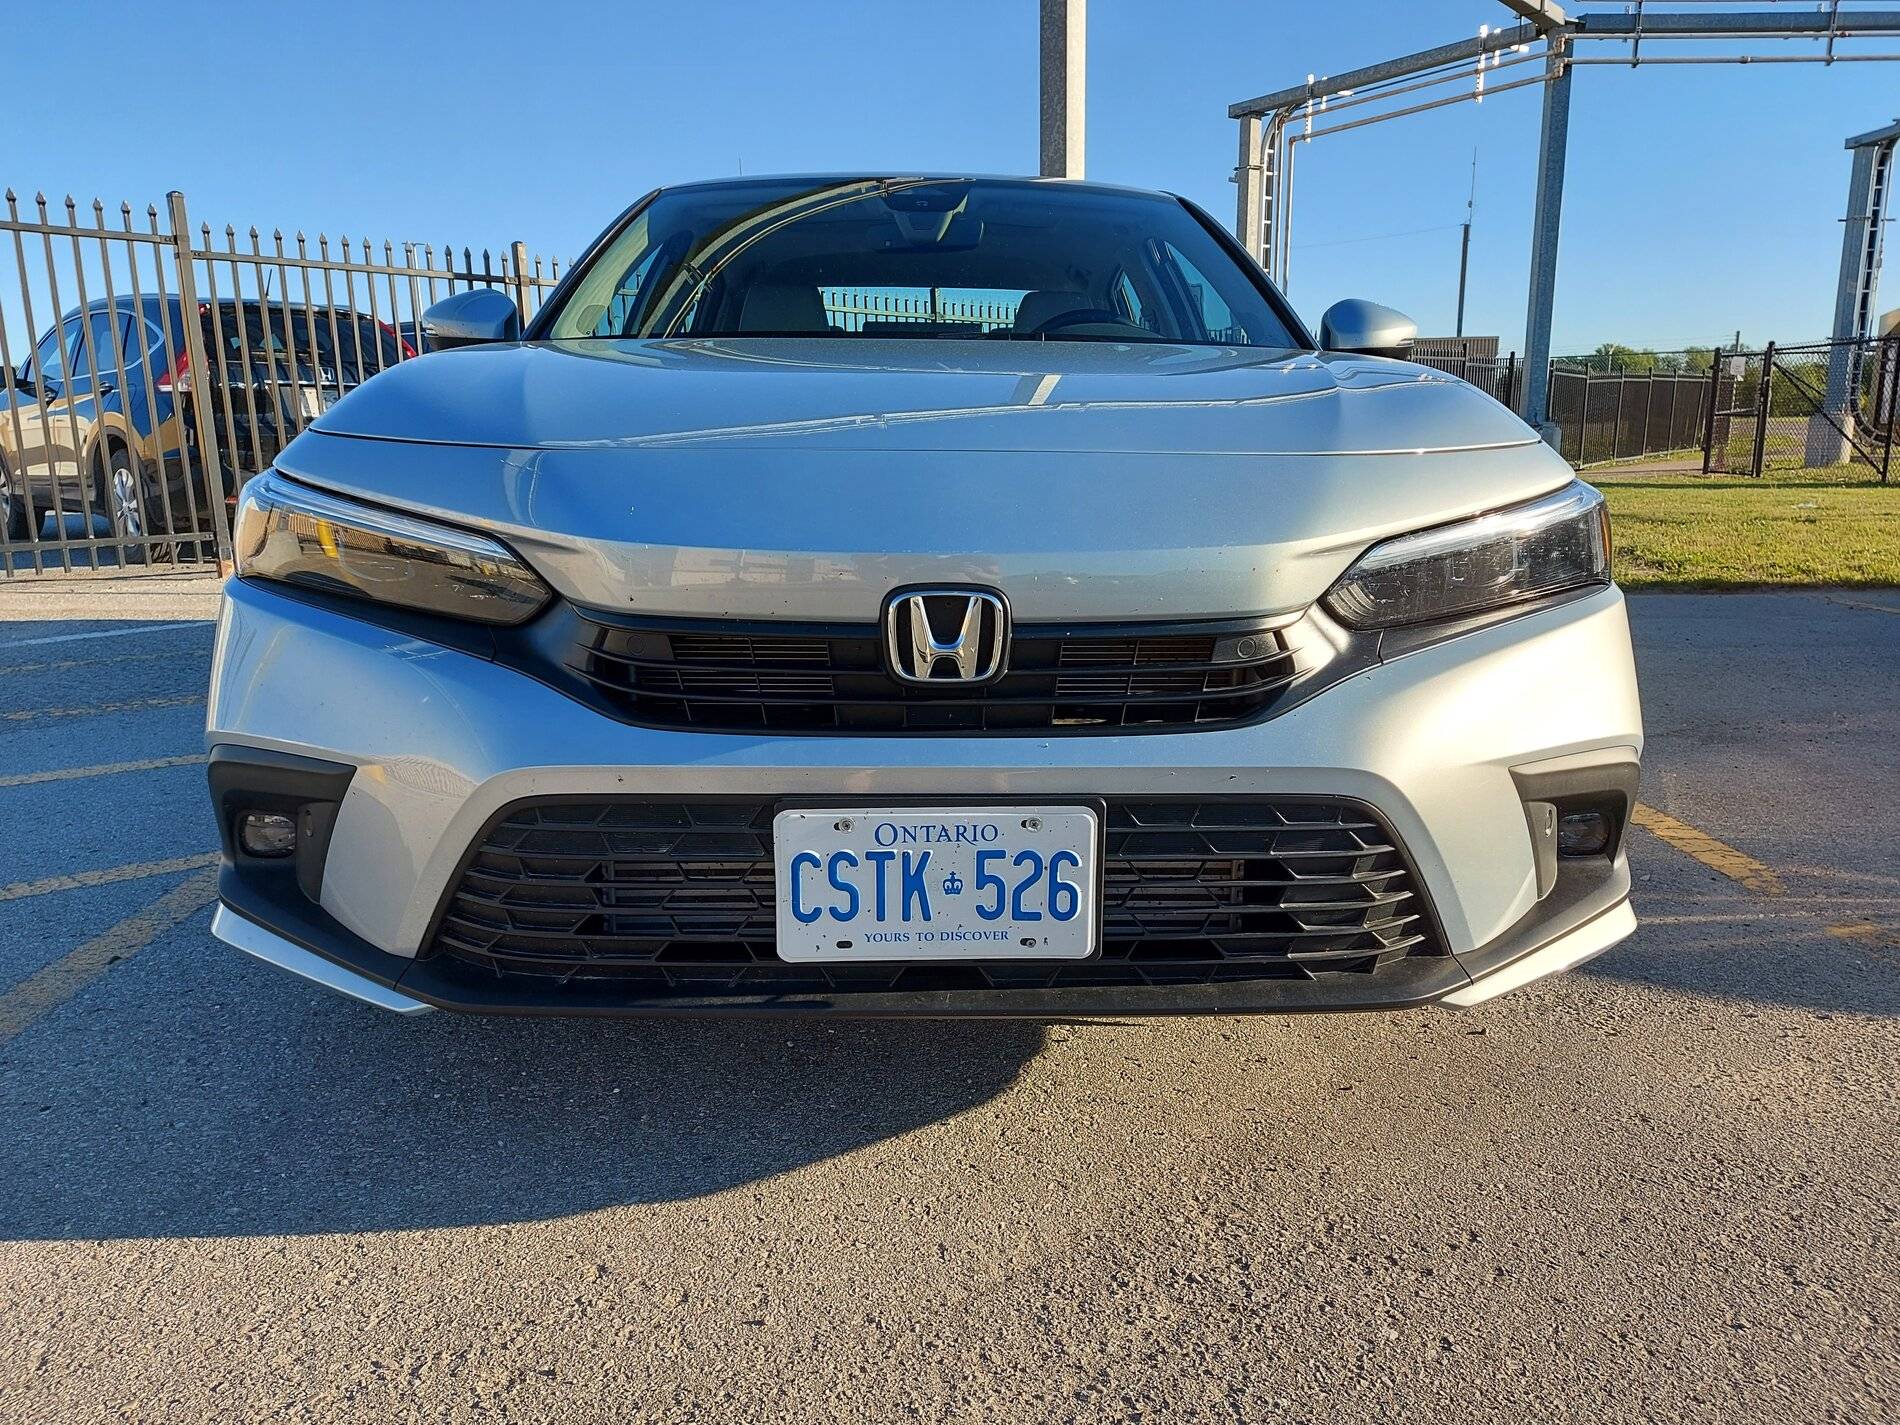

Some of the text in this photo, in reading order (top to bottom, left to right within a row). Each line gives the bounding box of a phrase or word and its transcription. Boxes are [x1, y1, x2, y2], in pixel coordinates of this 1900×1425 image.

[791, 849, 1082, 923] CSTK 526
[864, 930, 1009, 943] YOURS TO DISCOVER
